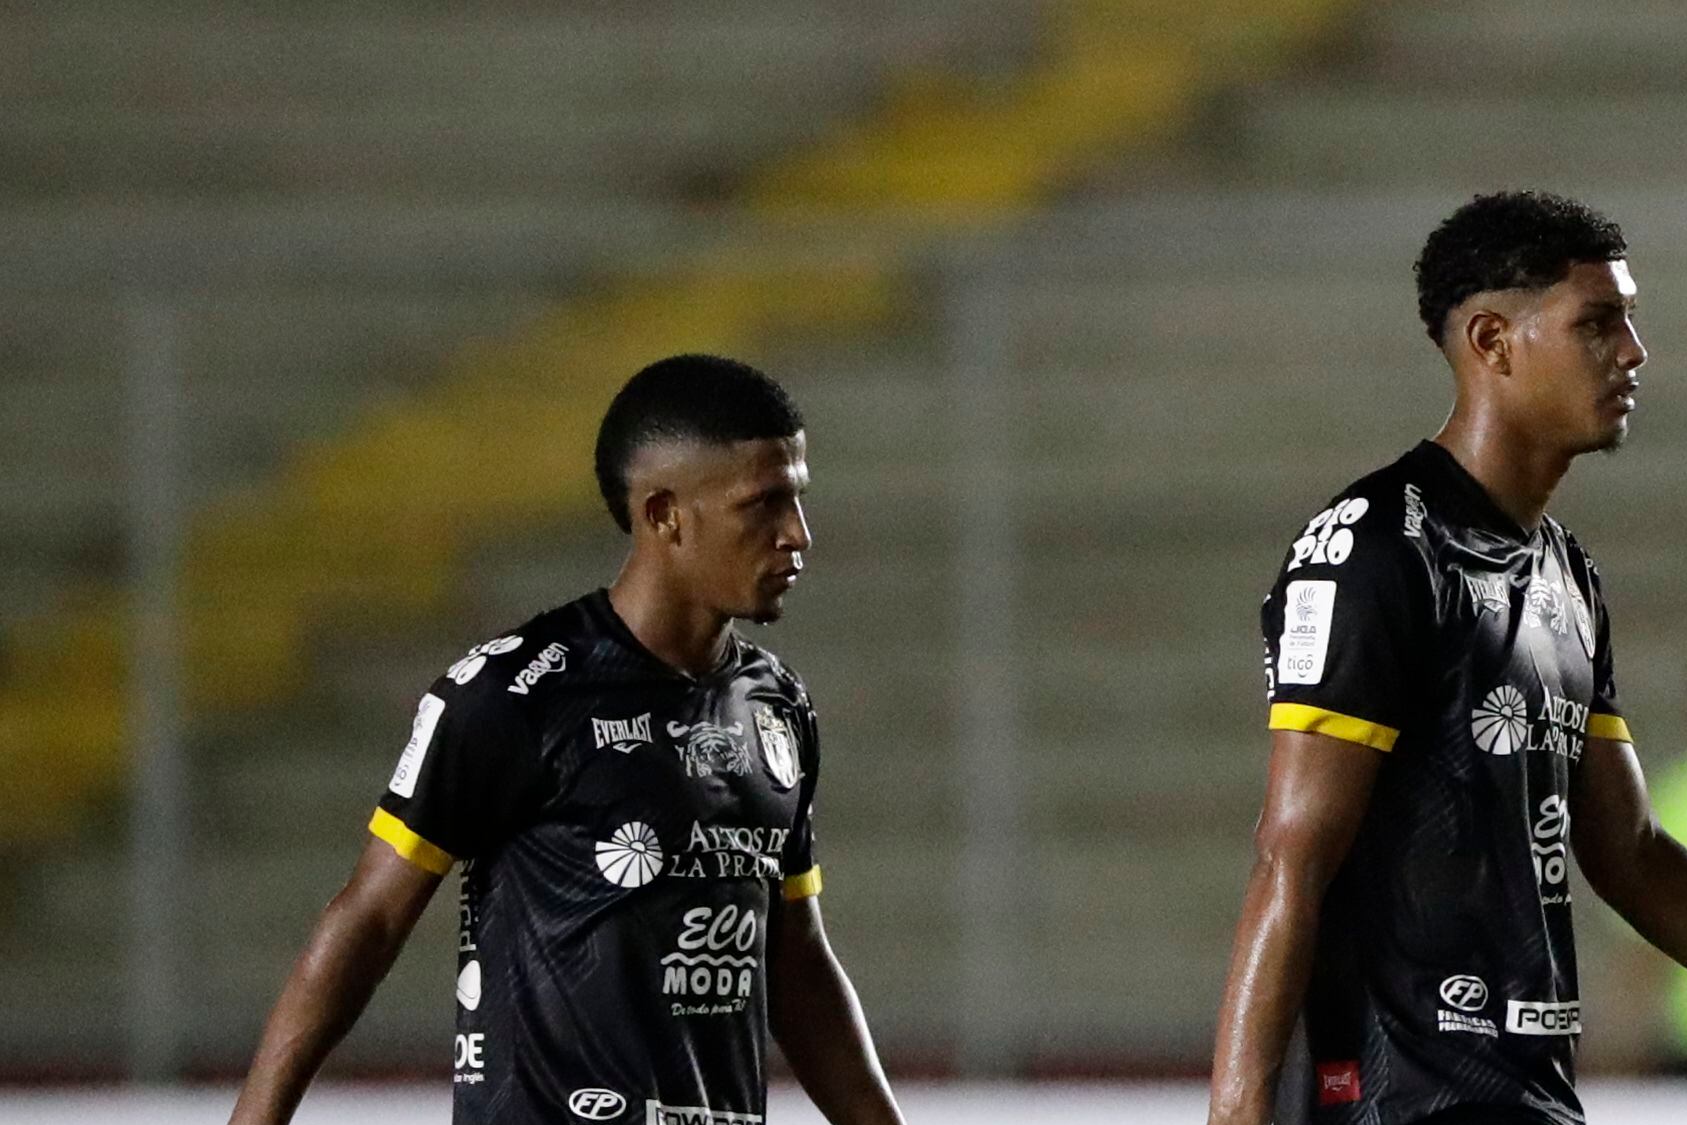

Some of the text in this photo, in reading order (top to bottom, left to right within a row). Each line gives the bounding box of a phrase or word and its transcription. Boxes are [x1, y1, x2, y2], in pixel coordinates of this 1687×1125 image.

[591, 711, 653, 749] EVERLAST
[686, 820, 764, 854] ALTOS
[668, 855, 707, 877] LA
[678, 904, 756, 951] ECO
[663, 966, 751, 997] MODA
[1447, 979, 1483, 1007] FP
[576, 1093, 618, 1118] FP
